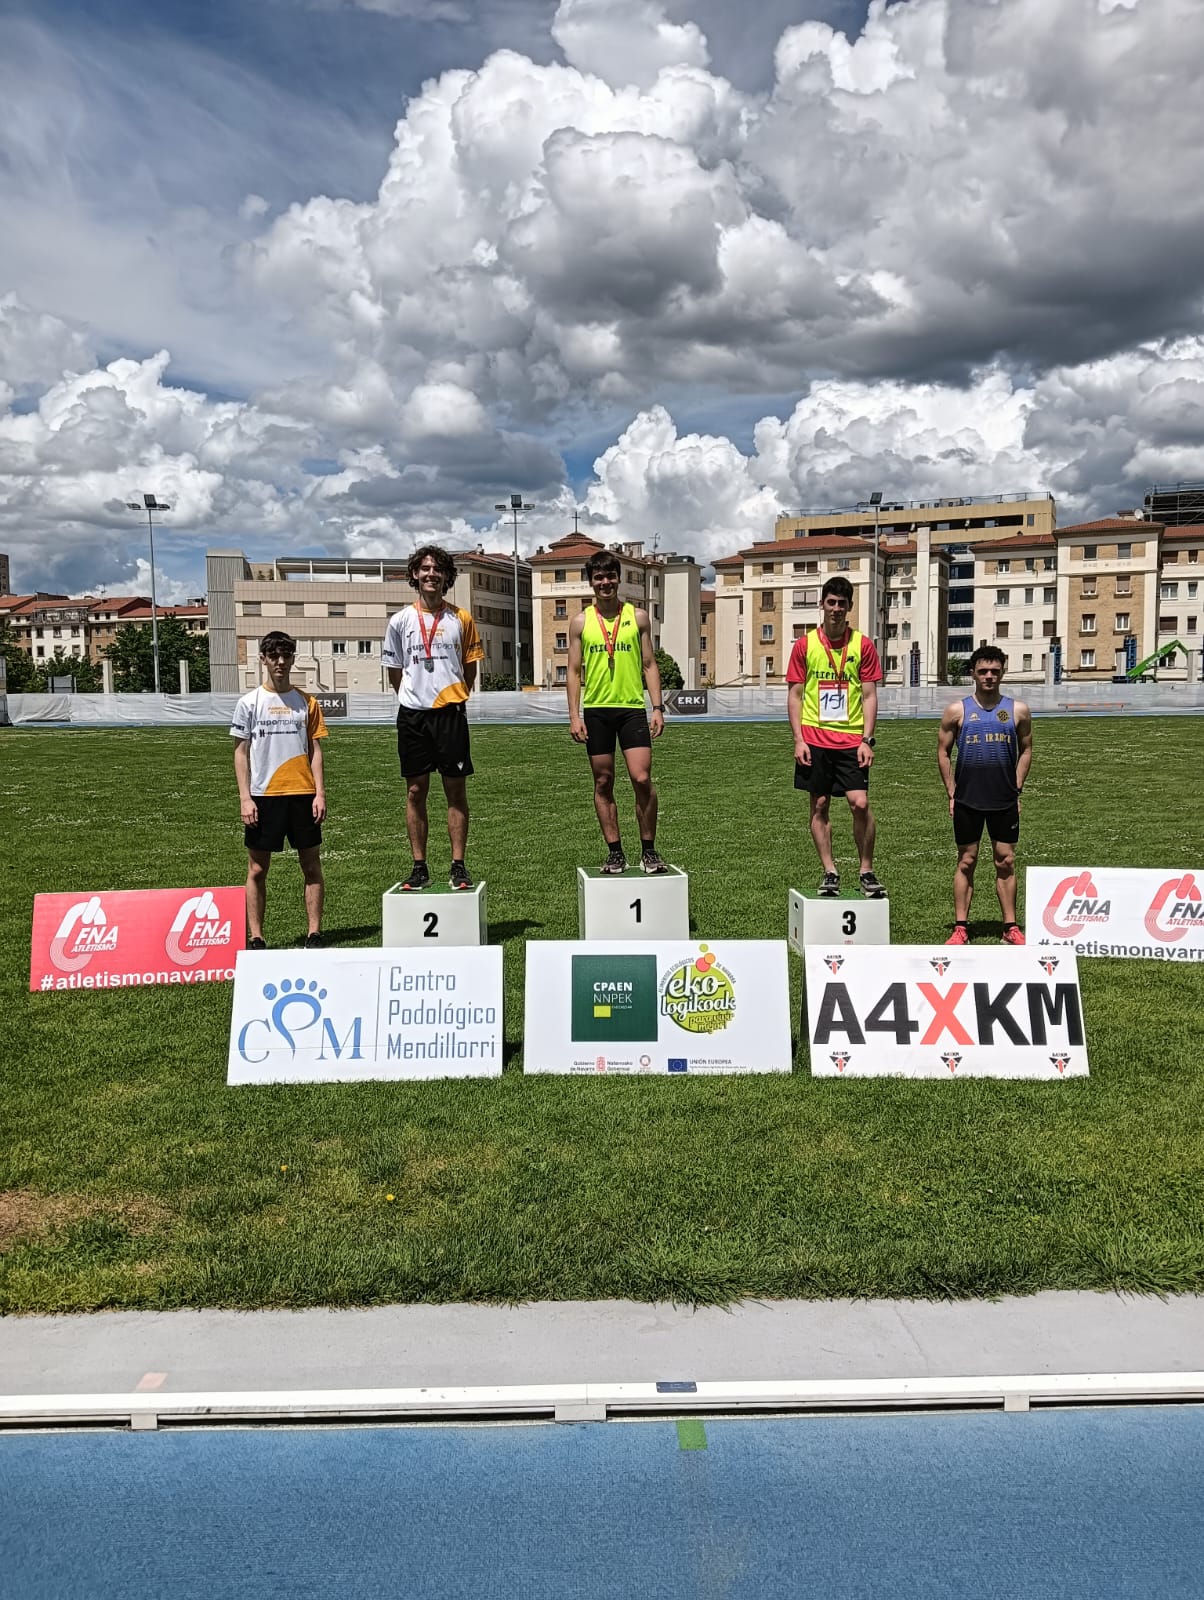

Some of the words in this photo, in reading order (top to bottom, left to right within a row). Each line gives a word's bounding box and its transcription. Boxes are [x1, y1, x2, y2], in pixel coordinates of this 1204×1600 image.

[677, 696, 705, 705] ERKi
[820, 692, 845, 711] 151
[629, 898, 643, 924] 1
[1066, 899, 1112, 916] FNA
[422, 912, 439, 938] 2
[842, 910, 857, 936] 3
[1063, 914, 1110, 923] ATLETISMO
[75, 925, 119, 945] FNA
[189, 920, 232, 939] FNA
[70, 942, 117, 953] ATLETISMO
[186, 936, 230, 947] ATLETISMO
[389, 966, 456, 992] Centro
[593, 981, 633, 992] CPAEN
[593, 993, 633, 1004] NNPEK
[660, 990, 737, 1022] logikoak
[387, 999, 496, 1031] Podológico
[812, 982, 1085, 1046] A4XKM
[386, 1032, 496, 1061] Mendillorri
